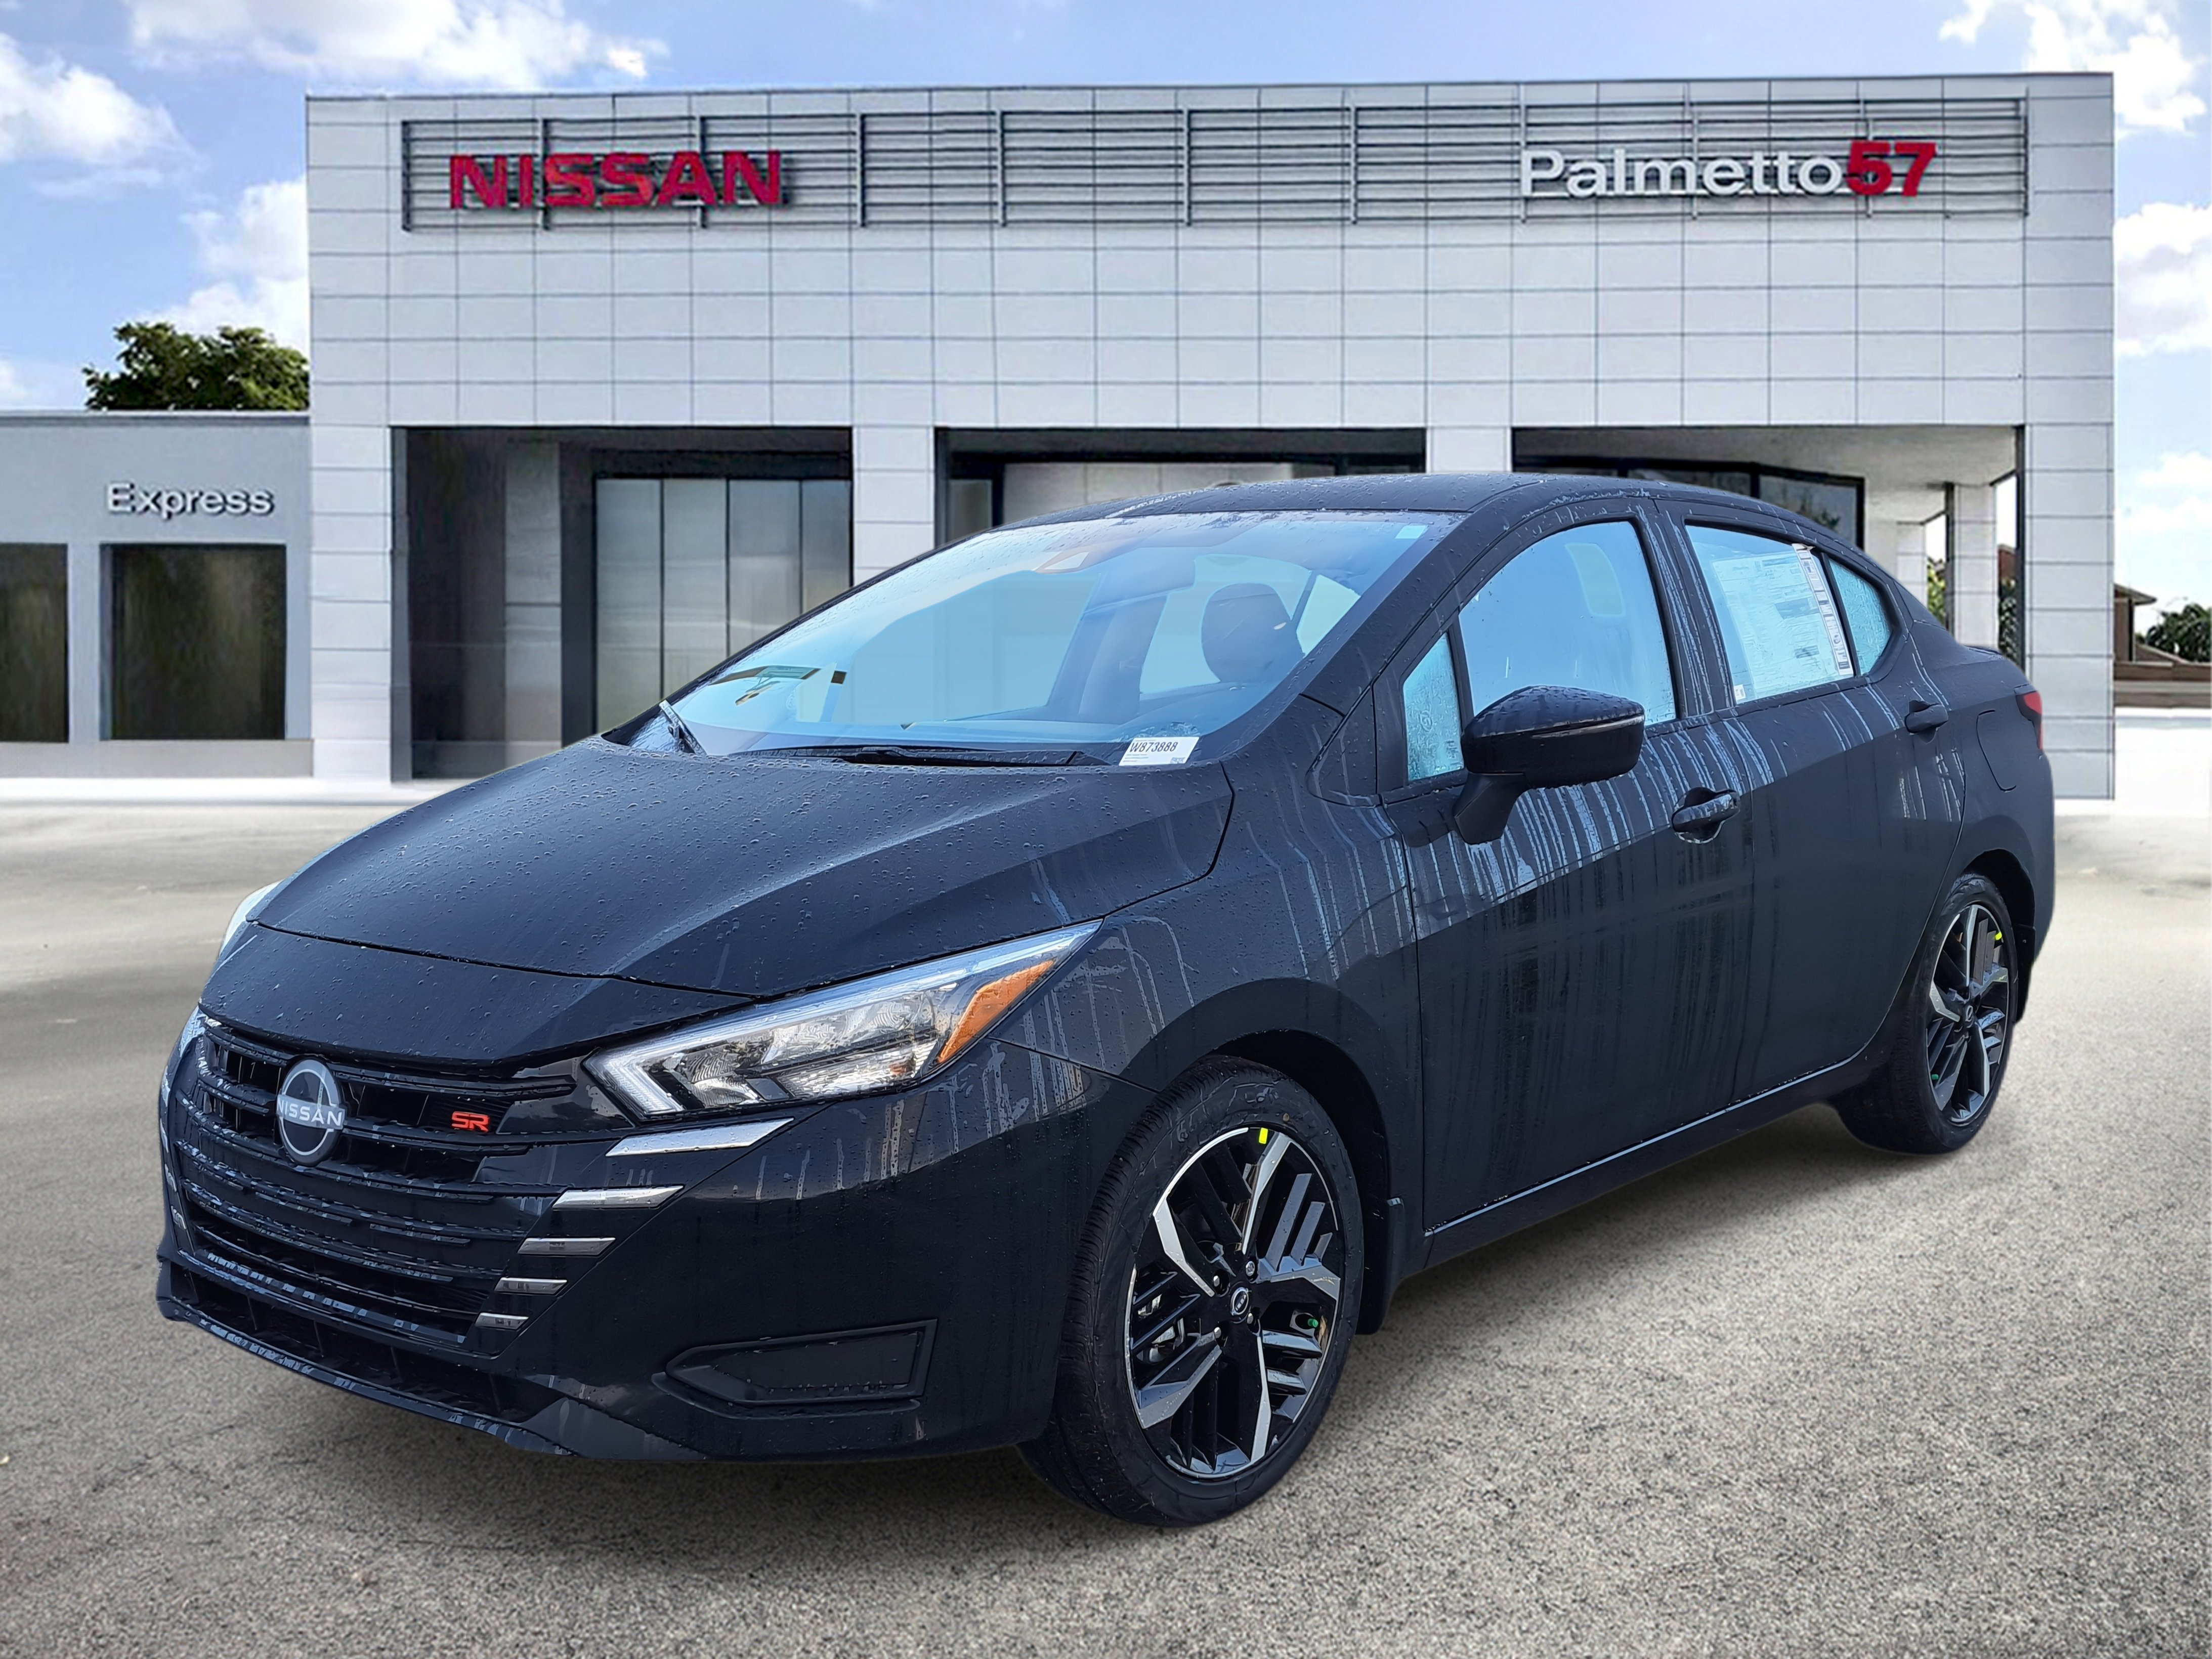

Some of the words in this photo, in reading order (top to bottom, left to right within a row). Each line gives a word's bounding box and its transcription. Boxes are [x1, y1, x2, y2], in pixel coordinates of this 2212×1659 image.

[449, 150, 782, 209] NISSAN
[107, 482, 275, 520] Express
[1129, 741, 1178, 753] W873888
[276, 1098, 343, 1127] NISSAN
[451, 1111, 490, 1133] SR
